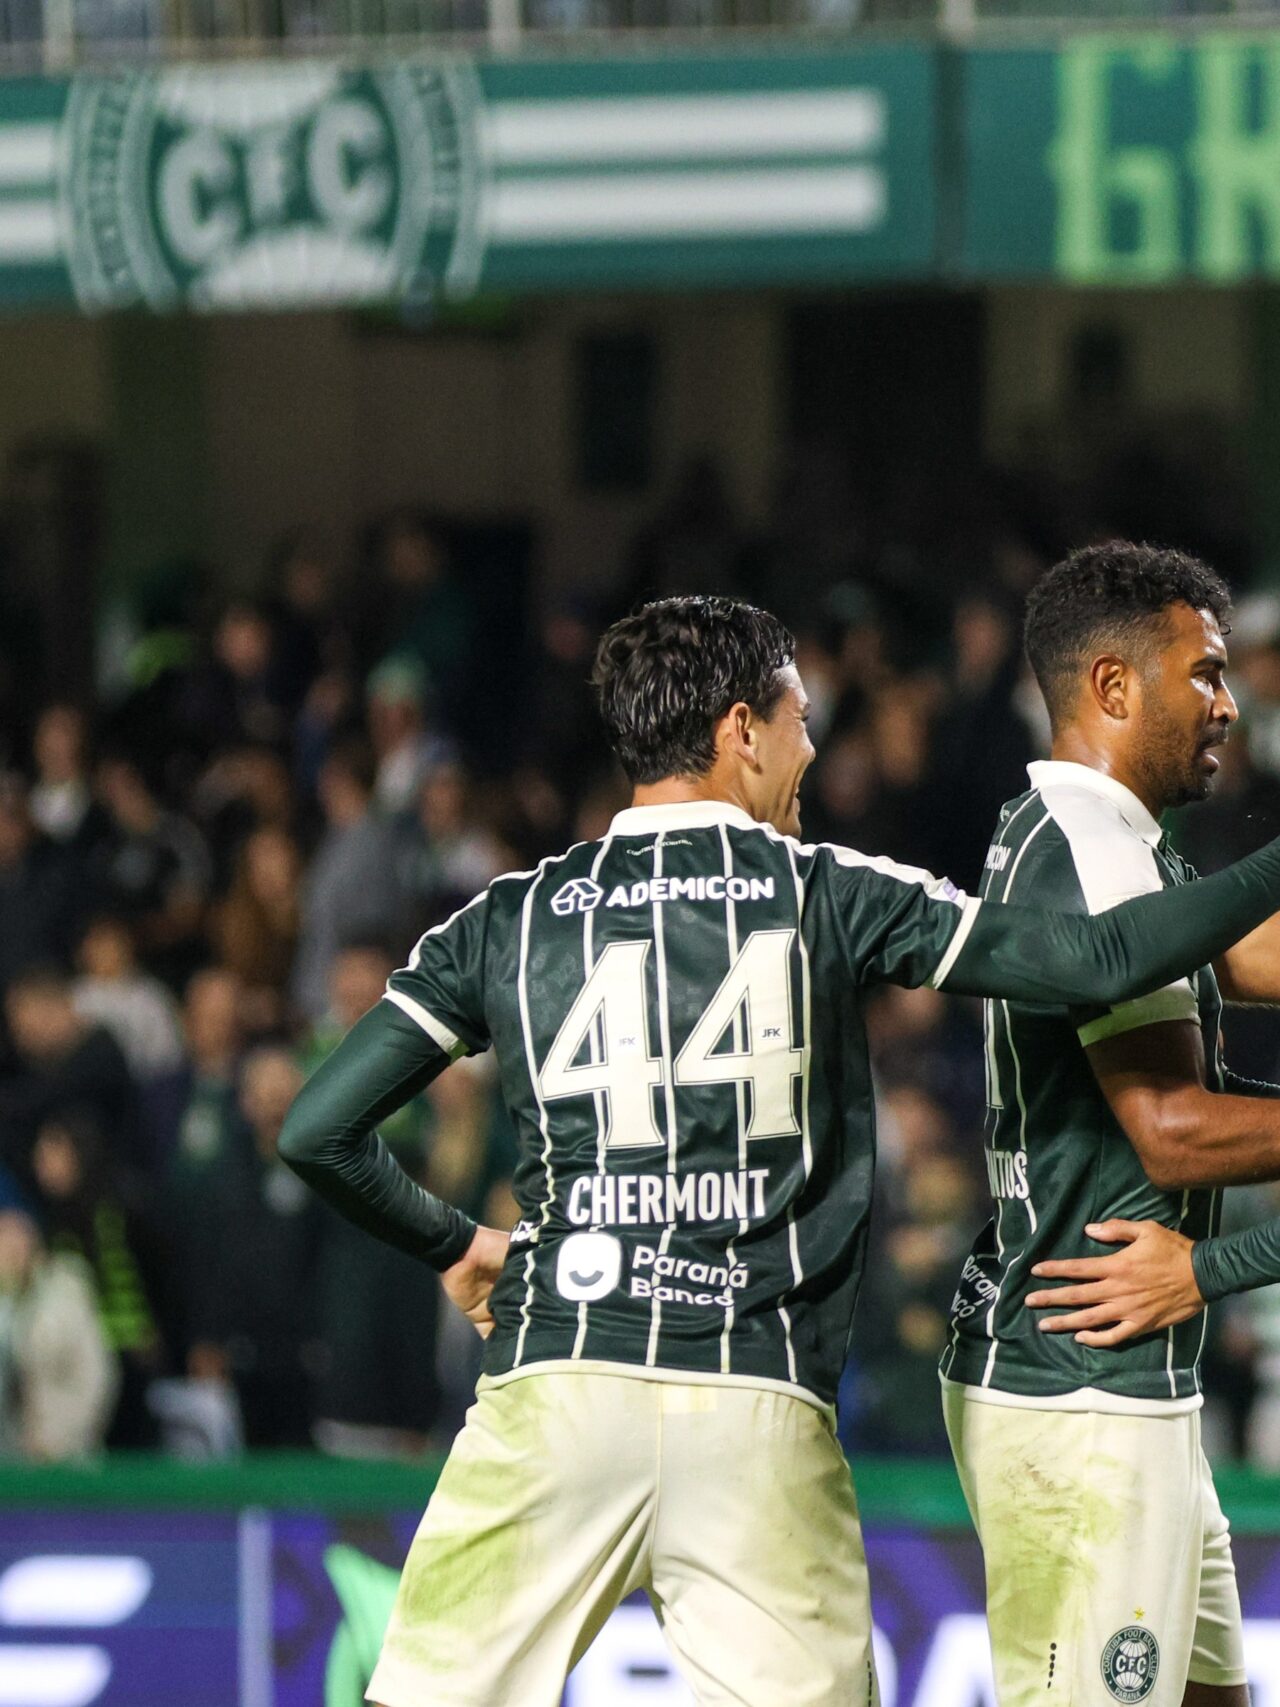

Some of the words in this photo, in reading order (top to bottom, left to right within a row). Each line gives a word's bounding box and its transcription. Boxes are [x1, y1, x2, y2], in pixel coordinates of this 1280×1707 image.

[606, 877, 774, 907] ADEMICON
[537, 928, 803, 1149] 44
[761, 1028, 781, 1038] JFK
[567, 1169, 769, 1225] CHERMONT
[632, 1245, 749, 1288] Paraná
[630, 1277, 734, 1306] Banco
[1115, 1654, 1147, 1676] CFC
